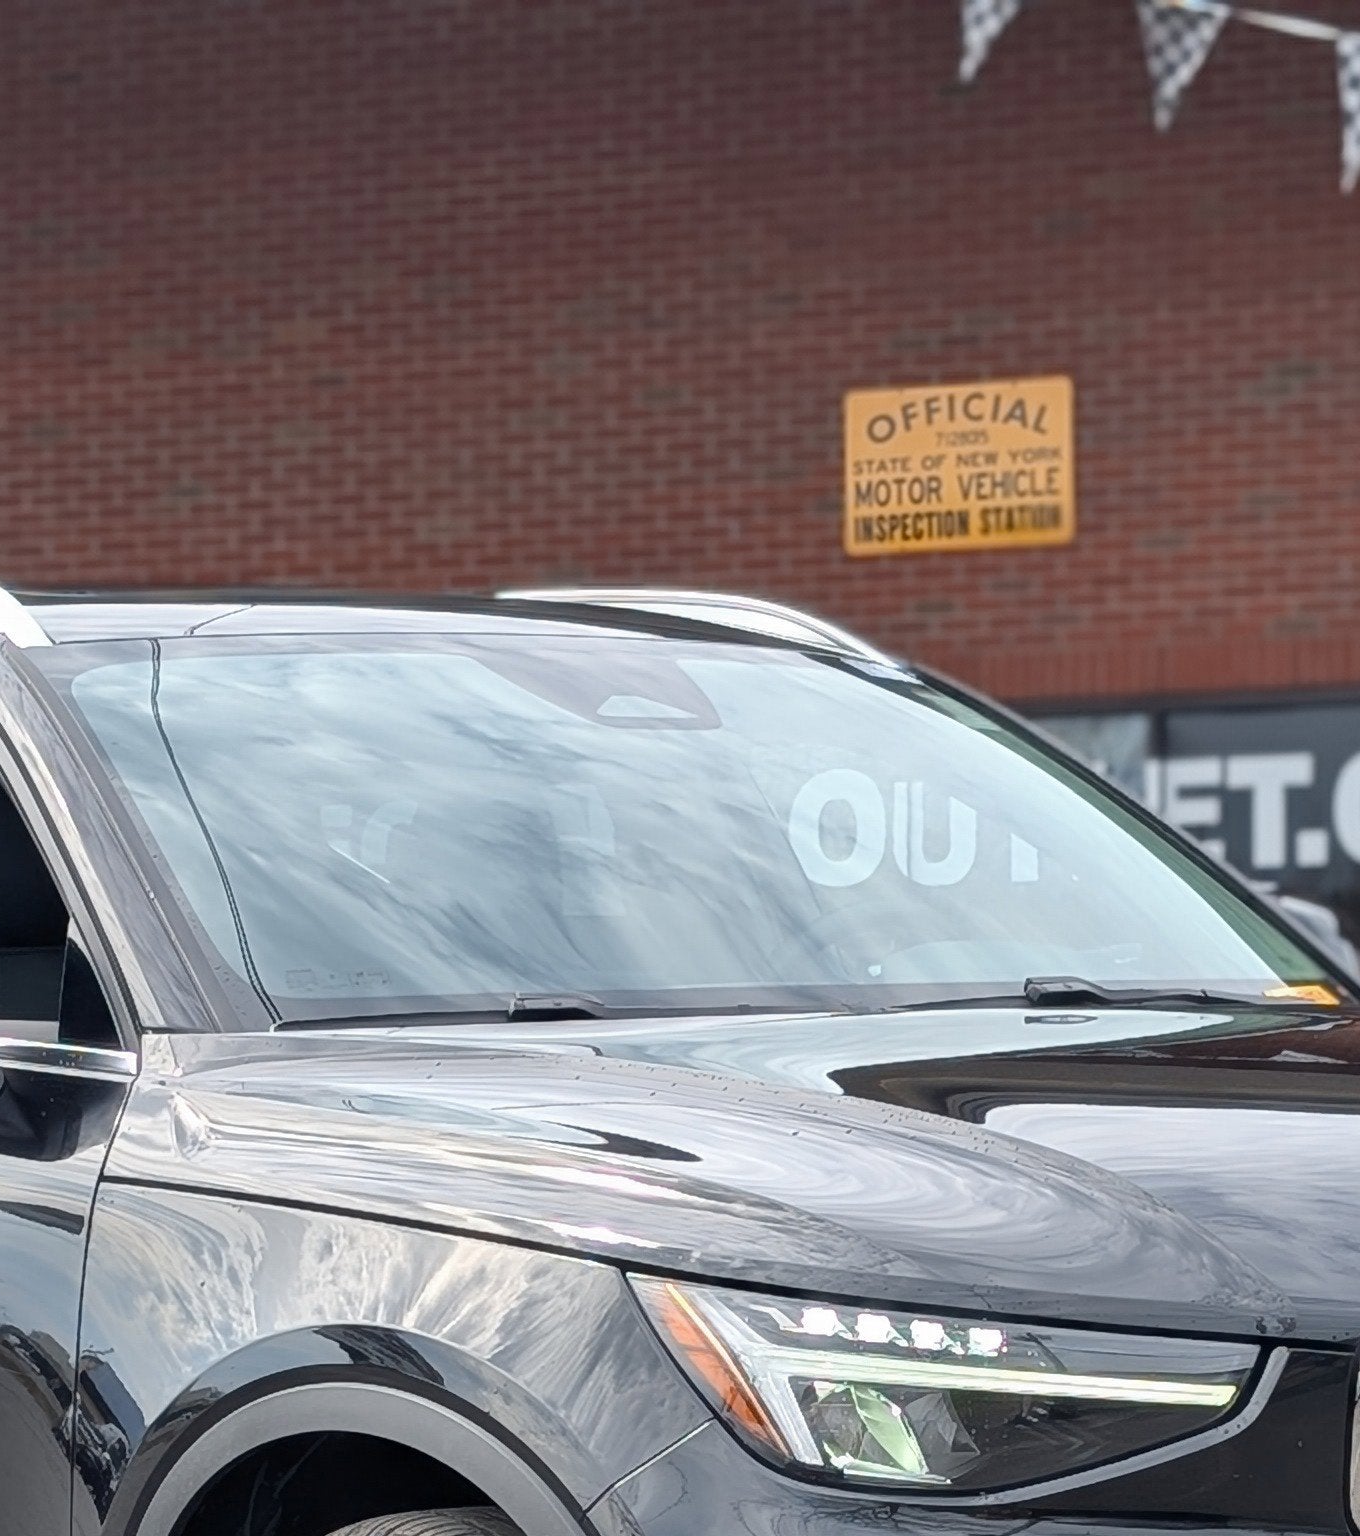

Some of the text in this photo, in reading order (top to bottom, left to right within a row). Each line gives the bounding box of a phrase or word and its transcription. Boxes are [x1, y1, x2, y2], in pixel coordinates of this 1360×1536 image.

[867, 392, 1048, 443] OFFICIAL
[853, 447, 1062, 476] STATE OF NEW YORK
[854, 467, 1060, 508] MOTOR VEHICLE
[854, 504, 1062, 543] INSPECTION STATION
